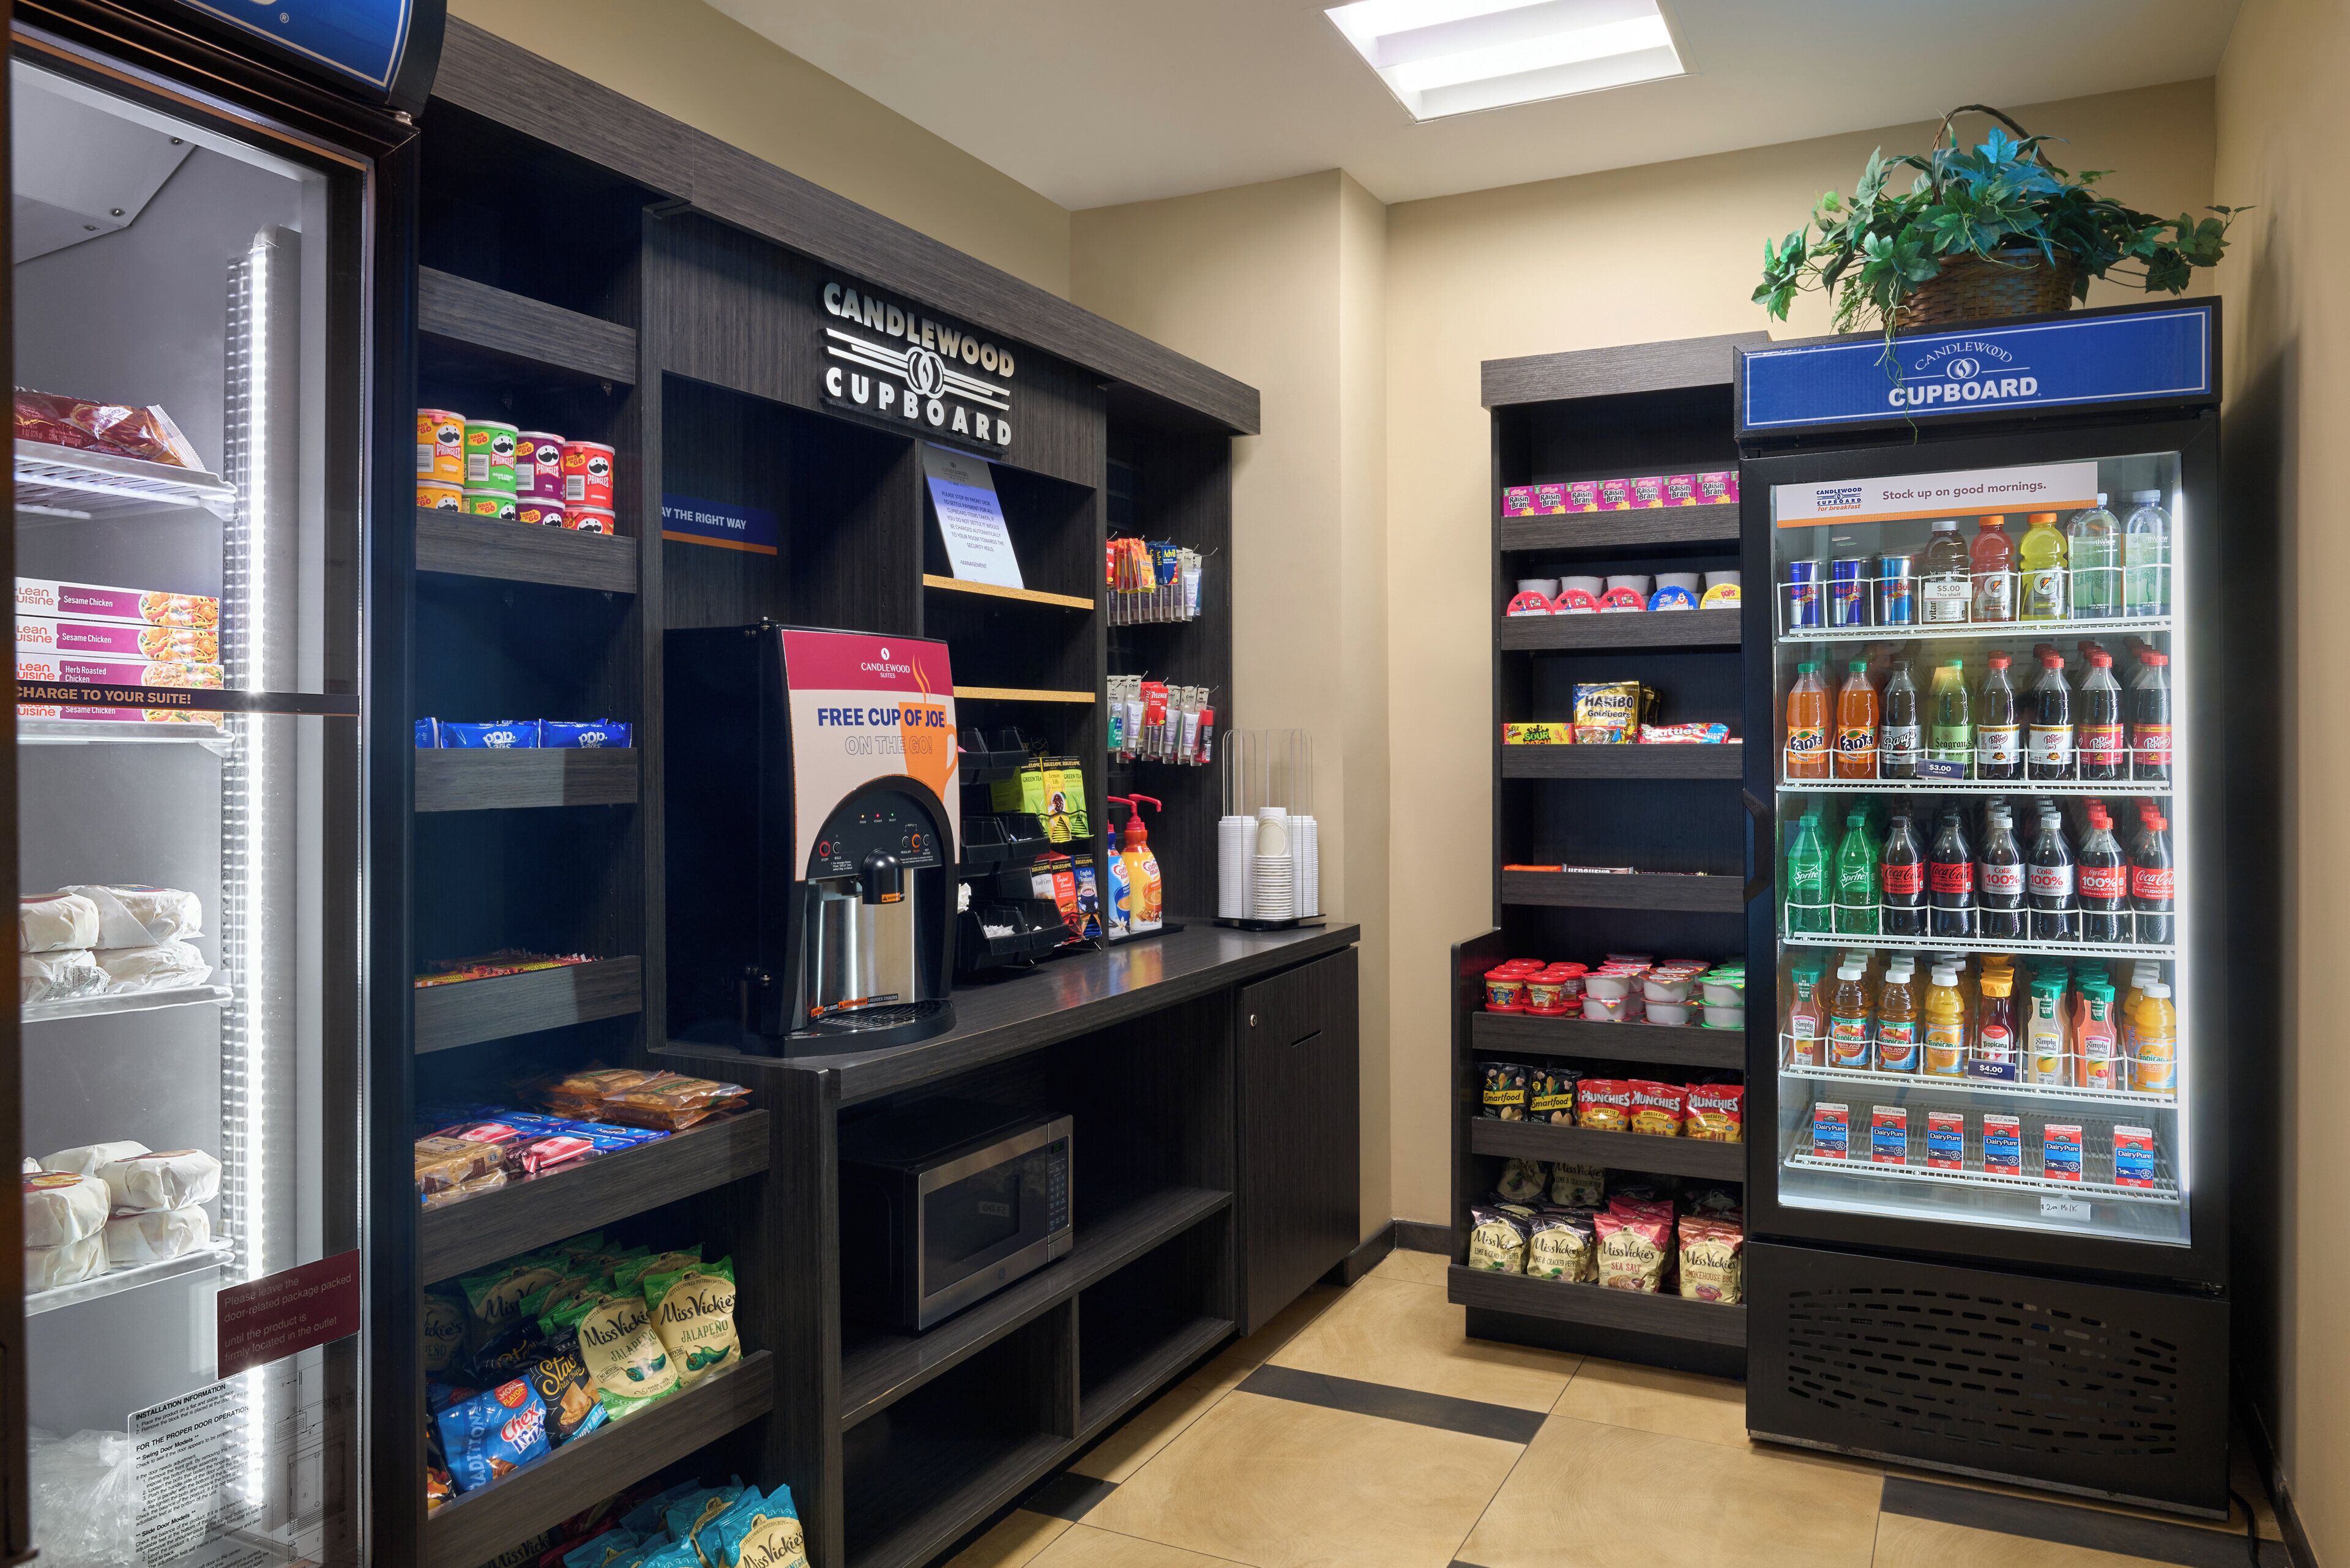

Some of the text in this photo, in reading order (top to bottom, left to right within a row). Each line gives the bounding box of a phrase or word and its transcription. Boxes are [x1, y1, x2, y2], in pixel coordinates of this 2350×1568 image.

[824, 282, 1015, 378] CANDLEWOOD
[1915, 342, 2012, 370] CANDLEWOOD
[1889, 377, 2038, 406] CUPBOARD
[826, 367, 1011, 446] CUPBOARD
[437, 444, 461, 459] PRINGLES
[492, 455, 513, 469] PRINGLES
[537, 464, 559, 477] PRINGLES
[588, 474, 609, 488] PRINGLES
[1882, 490, 1914, 501] Stock
[1917, 491, 1932, 500] up
[1953, 484, 1984, 496] good
[1988, 481, 2046, 493] mornings.
[1511, 501, 1528, 509] Bran
[662, 507, 747, 529] AY THE RIGHT WAY
[1163, 550, 1176, 558] Advil
[19, 588, 49, 597] Lean
[15, 596, 53, 605] uisine
[64, 596, 113, 607] Sesame Chicken
[17, 625, 47, 635] Lean
[62, 633, 111, 643] Sesame Chicken
[19, 663, 50, 672] Lean
[65, 665, 80, 674] Herb
[861, 662, 910, 673] CANDLEWOOD
[17, 686, 191, 704] CHARGE TO YOUR SUITE!
[1584, 696, 1633, 709] HARIBO
[818, 709, 945, 728] FREE CUP OF JOE
[1524, 731, 1549, 740] SOUR
[1646, 729, 1700, 739] Skittles
[1884, 730, 1917, 750] Barq's
[1989, 736, 2007, 744] Pepper
[845, 736, 933, 755] ON THE GO!
[1791, 735, 1824, 754] Fanta
[1840, 734, 1873, 753] Fanta
[1936, 737, 1971, 749] Seagram's
[1796, 871, 1819, 881] Sprite
[1842, 873, 1866, 882] Sprite
[1986, 875, 2020, 884] 100%
[2031, 875, 2063, 886] 100%
[2083, 876, 2116, 887] 100%
[2036, 1038, 2056, 1047] Simply
[1484, 1093, 1520, 1102] Smartfood
[1532, 1097, 1568, 1107] Smartfood
[1581, 1091, 1630, 1107] MUNCHIES
[1632, 1091, 1680, 1111] MUNCHIES
[1688, 1094, 1738, 1112] MUNCHIES
[1816, 1124, 1845, 1132] DairyPure
[1874, 1129, 1904, 1138] DairyPure
[1930, 1133, 1961, 1141] DairyPure
[1986, 1138, 2017, 1147] DairyPure
[2046, 1143, 2079, 1152] DairyPure
[1602, 1241, 1654, 1263] Miss Vickie's
[1611, 1262, 1641, 1272] SEA SALT
[1686, 1251, 1736, 1273] Miss Vickie's
[1685, 1269, 1720, 1282] SMOKEHOUSE
[225, 1291, 256, 1307] Please
[259, 1284, 283, 1296] leave
[225, 1274, 351, 1323] door-related package packed
[661, 1288, 736, 1326] Miss Vickie's
[225, 1334, 244, 1348] until
[264, 1317, 297, 1336] product
[584, 1326, 619, 1348] Miss
[681, 1319, 728, 1343] JALAPEÑO
[225, 1348, 249, 1362] firmly
[252, 1335, 285, 1352] located
[314, 1316, 337, 1331] outlet
[612, 1329, 657, 1361] JALAPEÑO
[500, 1381, 518, 1398] MORE
[503, 1387, 524, 1406] FLAVOR
[136, 1384, 225, 1421] INSTALLATION INFORMATION
[501, 1400, 539, 1442] Chex
[136, 1406, 250, 1452] FOR THE PROPER DOOR OPERATION.
[758, 1531, 803, 1563] Vickie's
